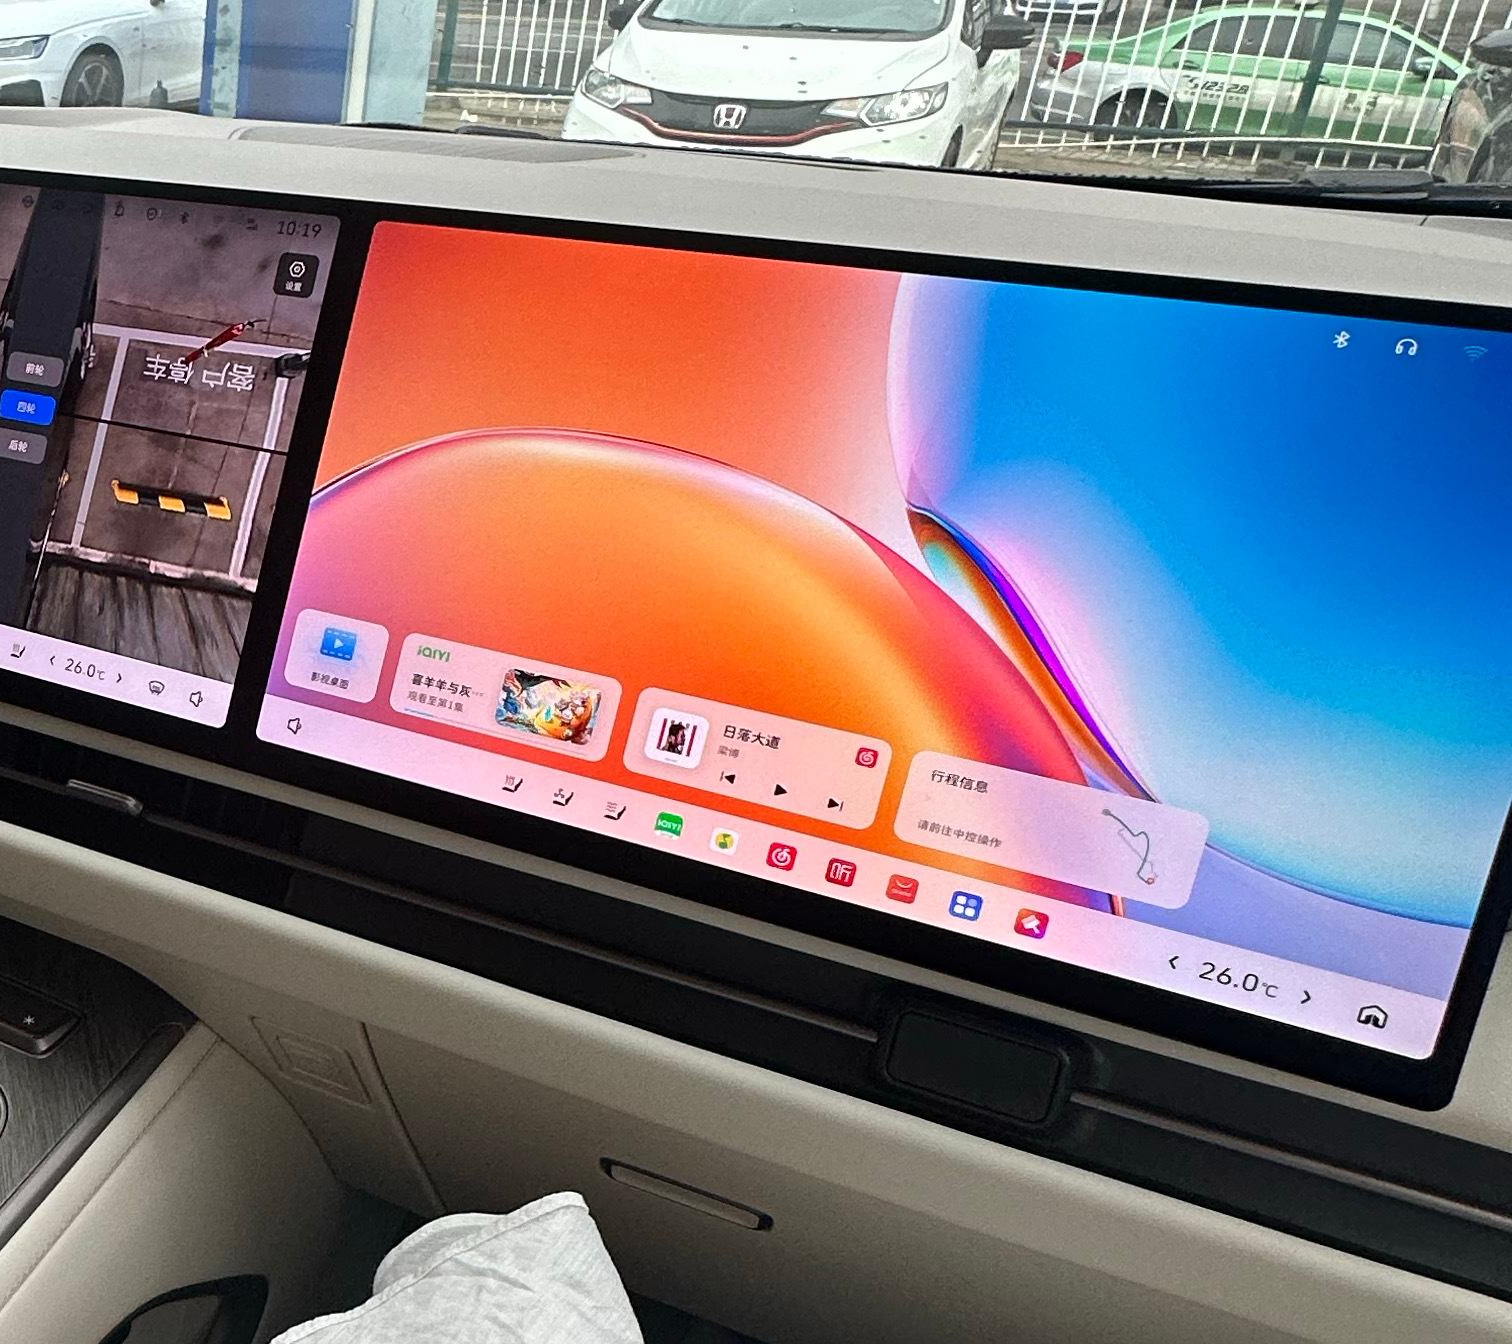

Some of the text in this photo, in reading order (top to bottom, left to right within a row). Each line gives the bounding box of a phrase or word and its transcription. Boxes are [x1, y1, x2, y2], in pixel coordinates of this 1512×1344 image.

[277, 221, 322, 238] 10:19
[8, 439, 28, 453] 后轮
[723, 724, 781, 750] 日落大道
[931, 769, 988, 794] 行程信息
[830, 862, 853, 883] 听
